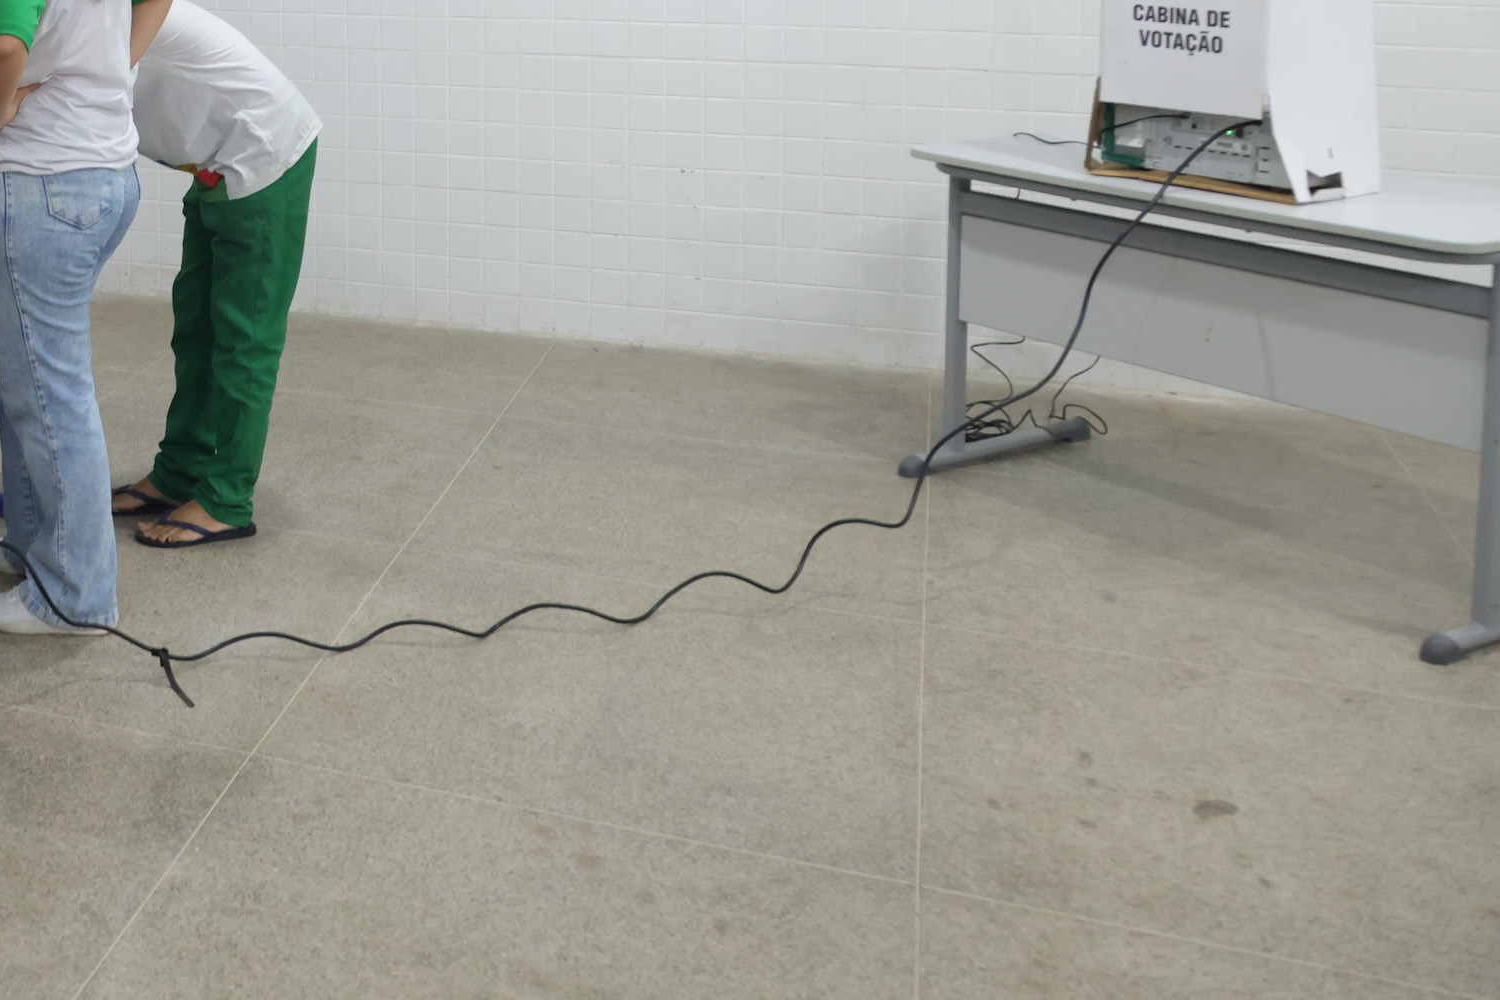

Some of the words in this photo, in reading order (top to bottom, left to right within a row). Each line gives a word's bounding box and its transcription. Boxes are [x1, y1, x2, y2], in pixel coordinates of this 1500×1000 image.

[1132, 3, 1201, 27] CABINA
[1206, 9, 1231, 29] DE
[1138, 29, 1224, 57] VOTAÇÃO
